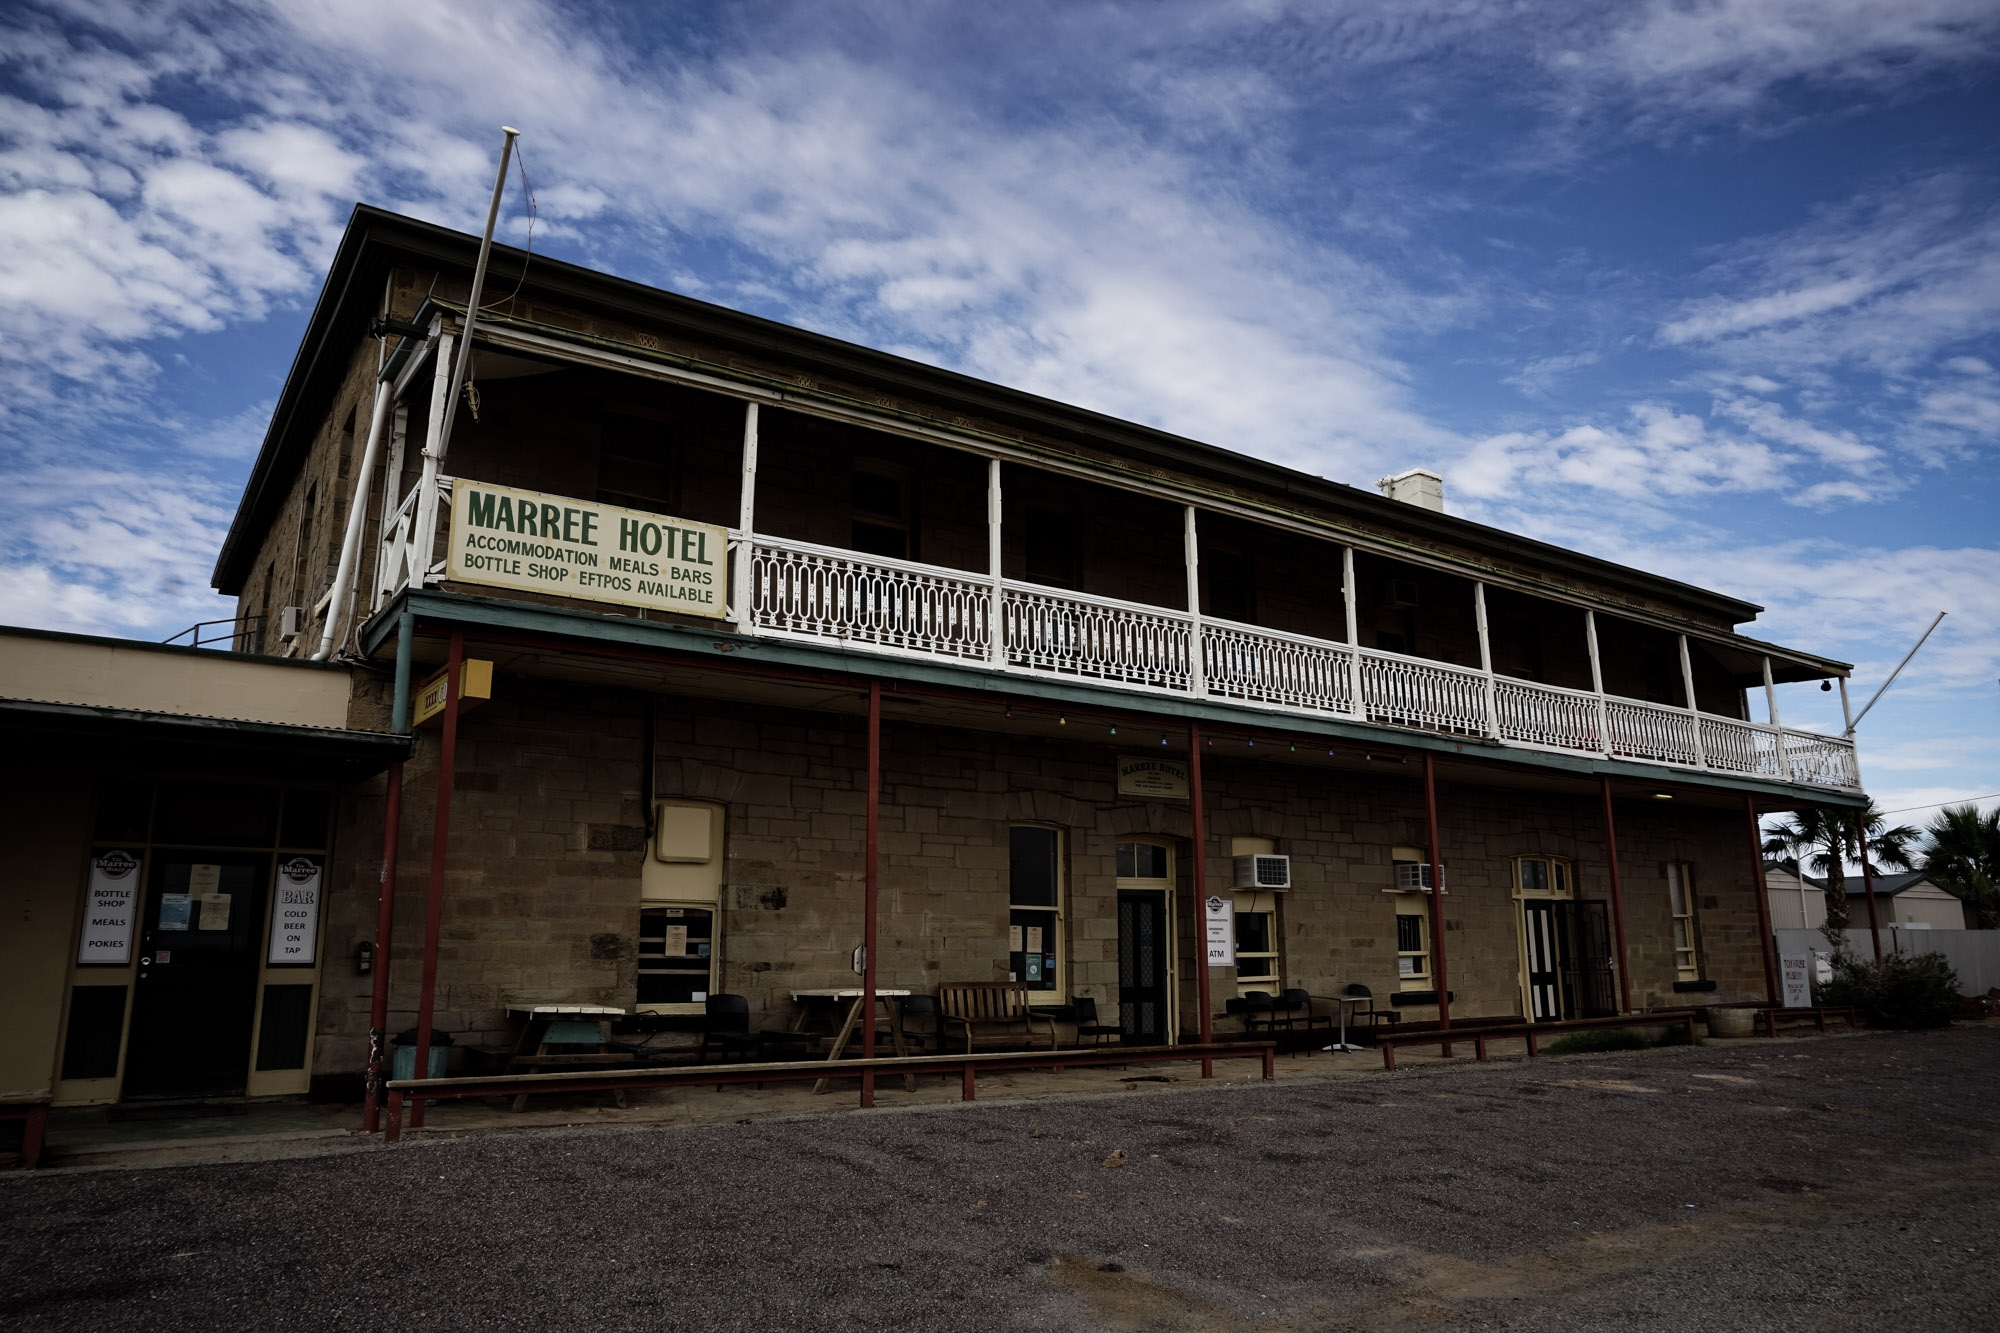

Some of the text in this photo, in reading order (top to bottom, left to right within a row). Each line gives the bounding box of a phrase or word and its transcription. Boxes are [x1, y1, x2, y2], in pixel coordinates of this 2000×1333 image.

[468, 490, 713, 566] MARREE HOTEL
[466, 533, 713, 585] ACCOMMODATION MEALS BARS
[464, 553, 713, 604] BOTTLE SHOP EFTPOS AVAILABLE
[1121, 762, 1186, 780] MARREE HOTEL
[97, 859, 136, 868] Marree
[283, 866, 317, 874] Marree
[94, 890, 131, 898] BOTTLE
[281, 889, 314, 904] BAR
[89, 940, 124, 948] POKIES
